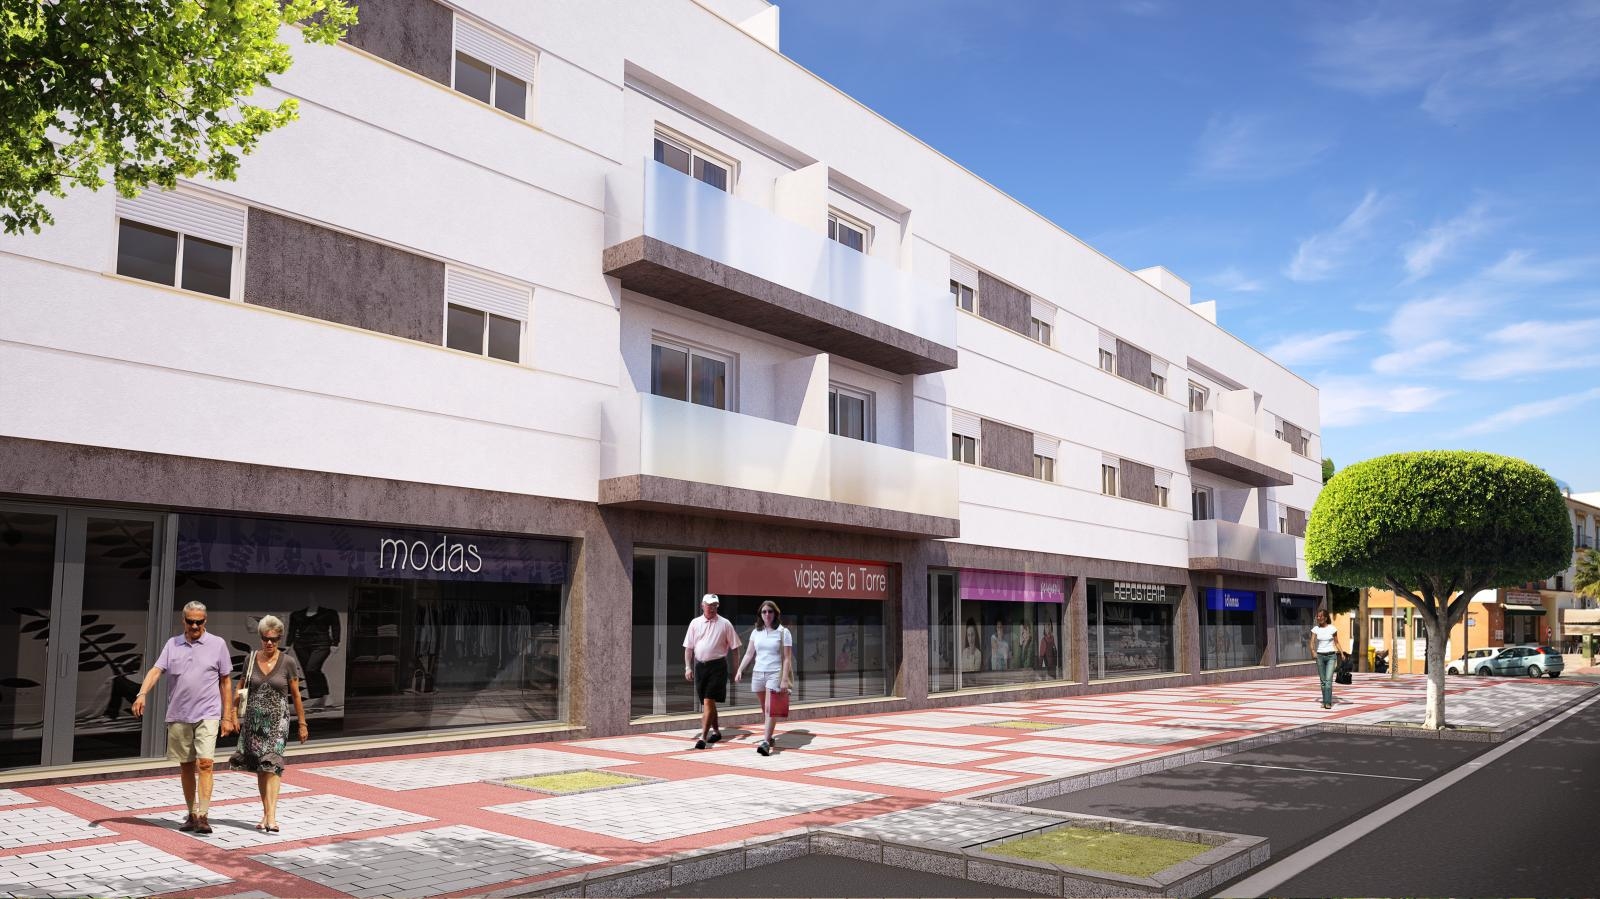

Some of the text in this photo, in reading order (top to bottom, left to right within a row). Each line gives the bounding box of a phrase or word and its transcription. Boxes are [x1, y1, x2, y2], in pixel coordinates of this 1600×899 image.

[380, 535, 482, 573] modas
[794, 563, 886, 594] viajes de la Torre
